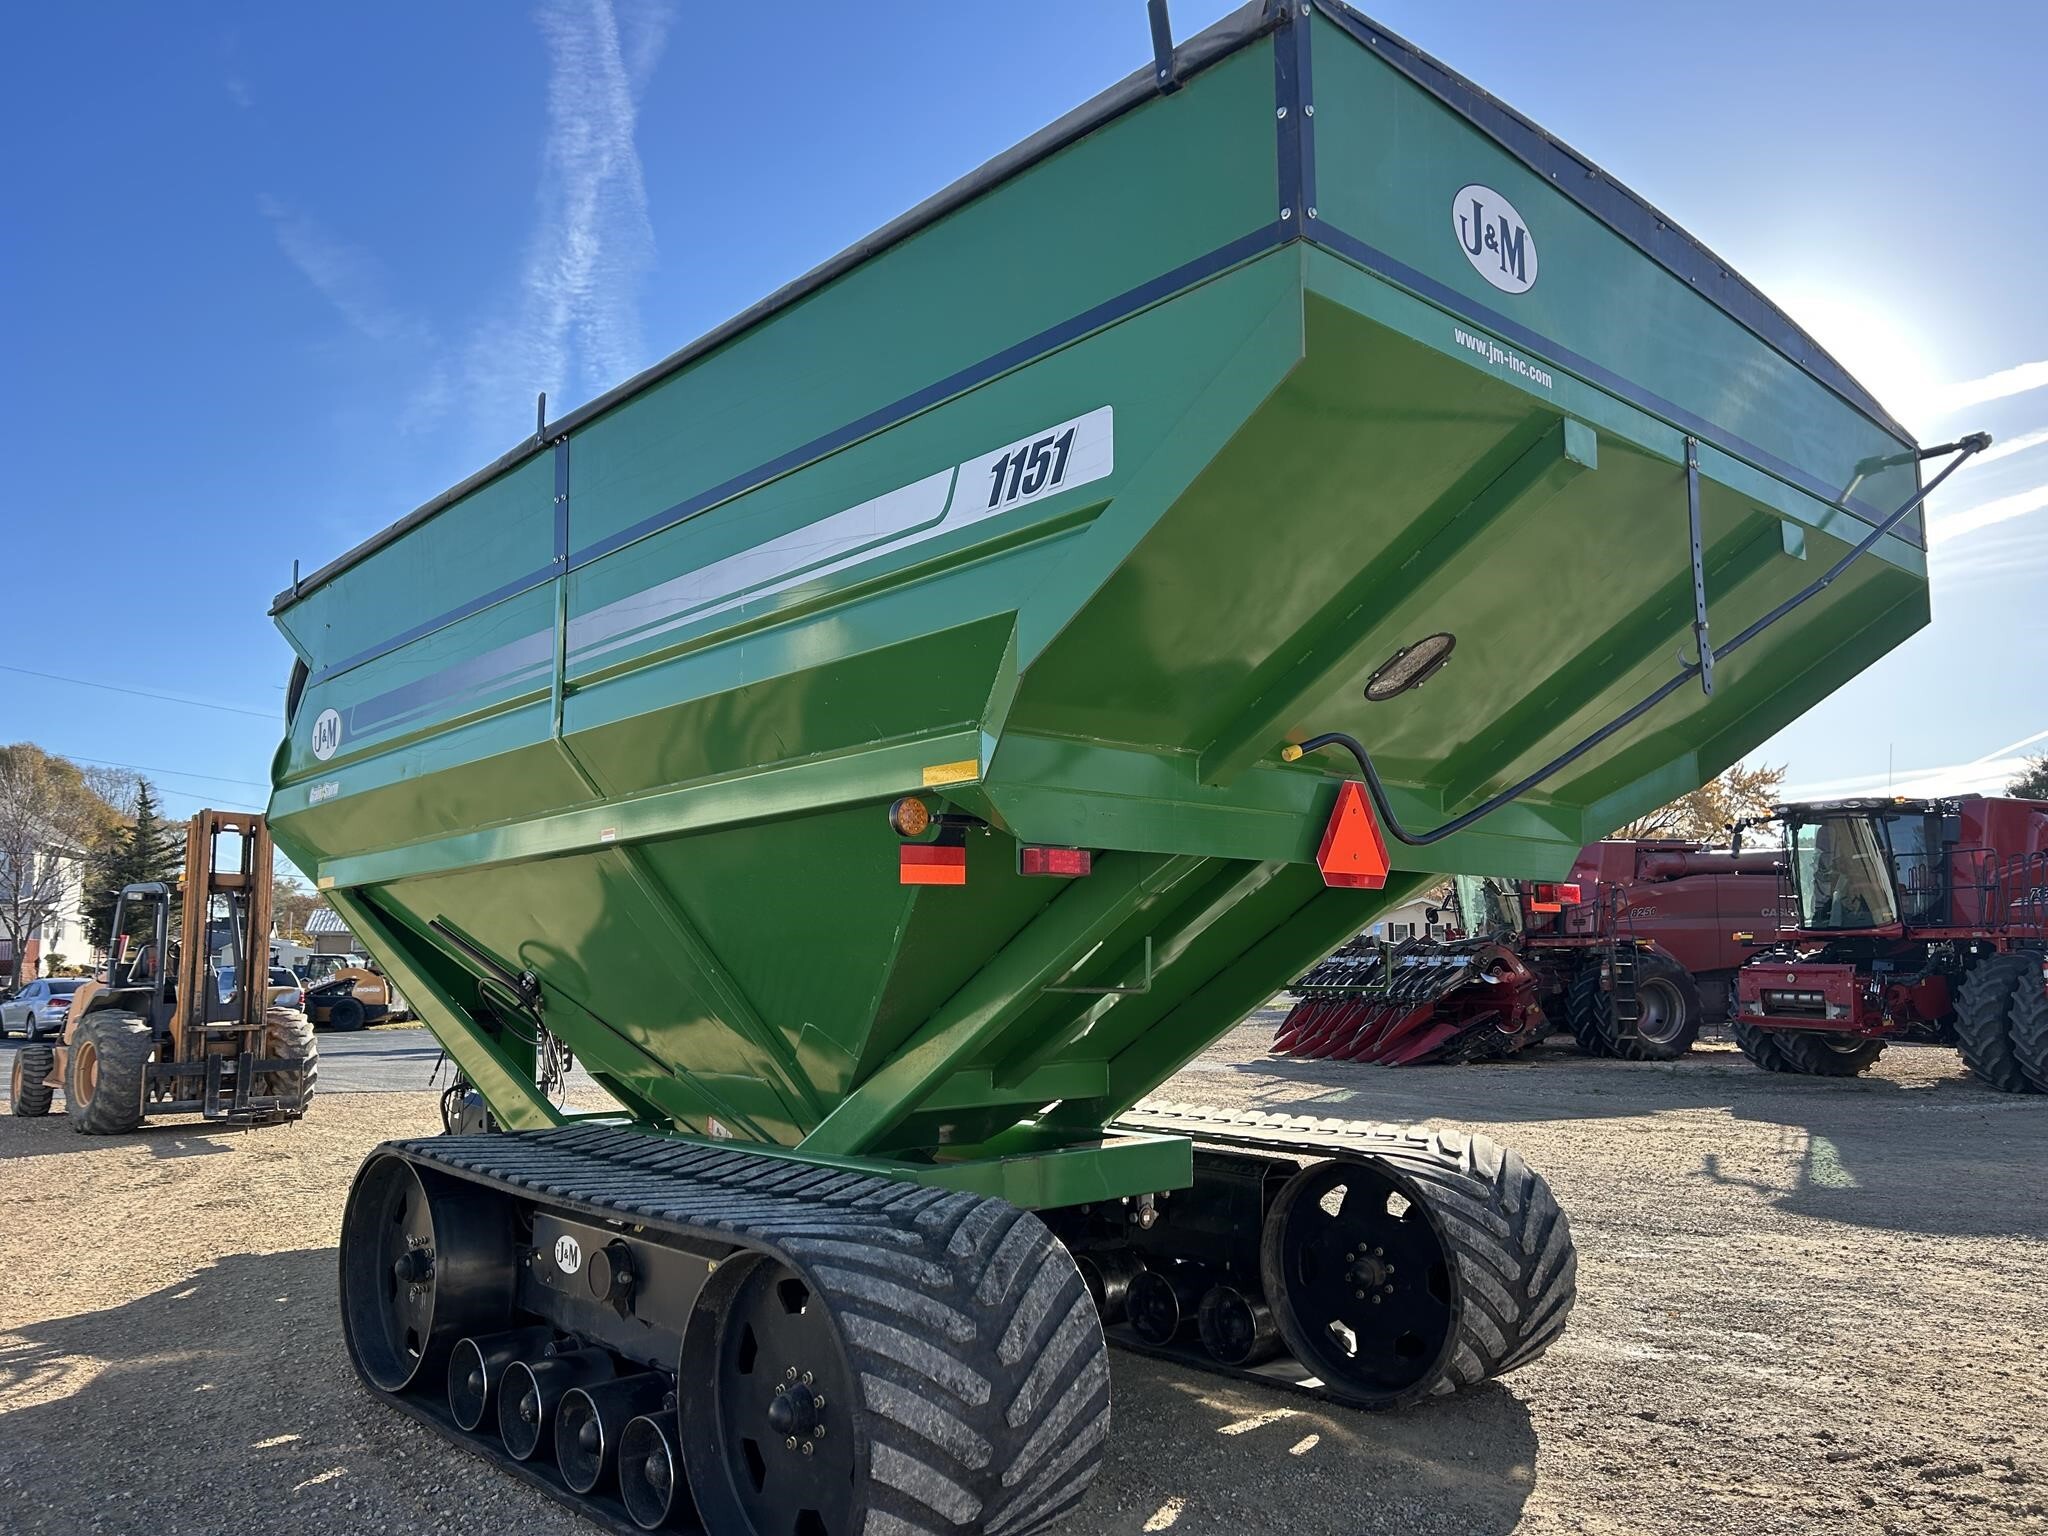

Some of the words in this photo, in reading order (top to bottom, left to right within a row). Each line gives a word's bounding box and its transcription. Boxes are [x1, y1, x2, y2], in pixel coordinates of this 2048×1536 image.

[1459, 198, 1527, 284] J&M
[1454, 327, 1553, 389] www.jm-inc.com
[987, 426, 1076, 508] 1151
[314, 717, 338, 753] J&M
[307, 973, 336, 989] CASE
[556, 1241, 578, 1268] J&M
